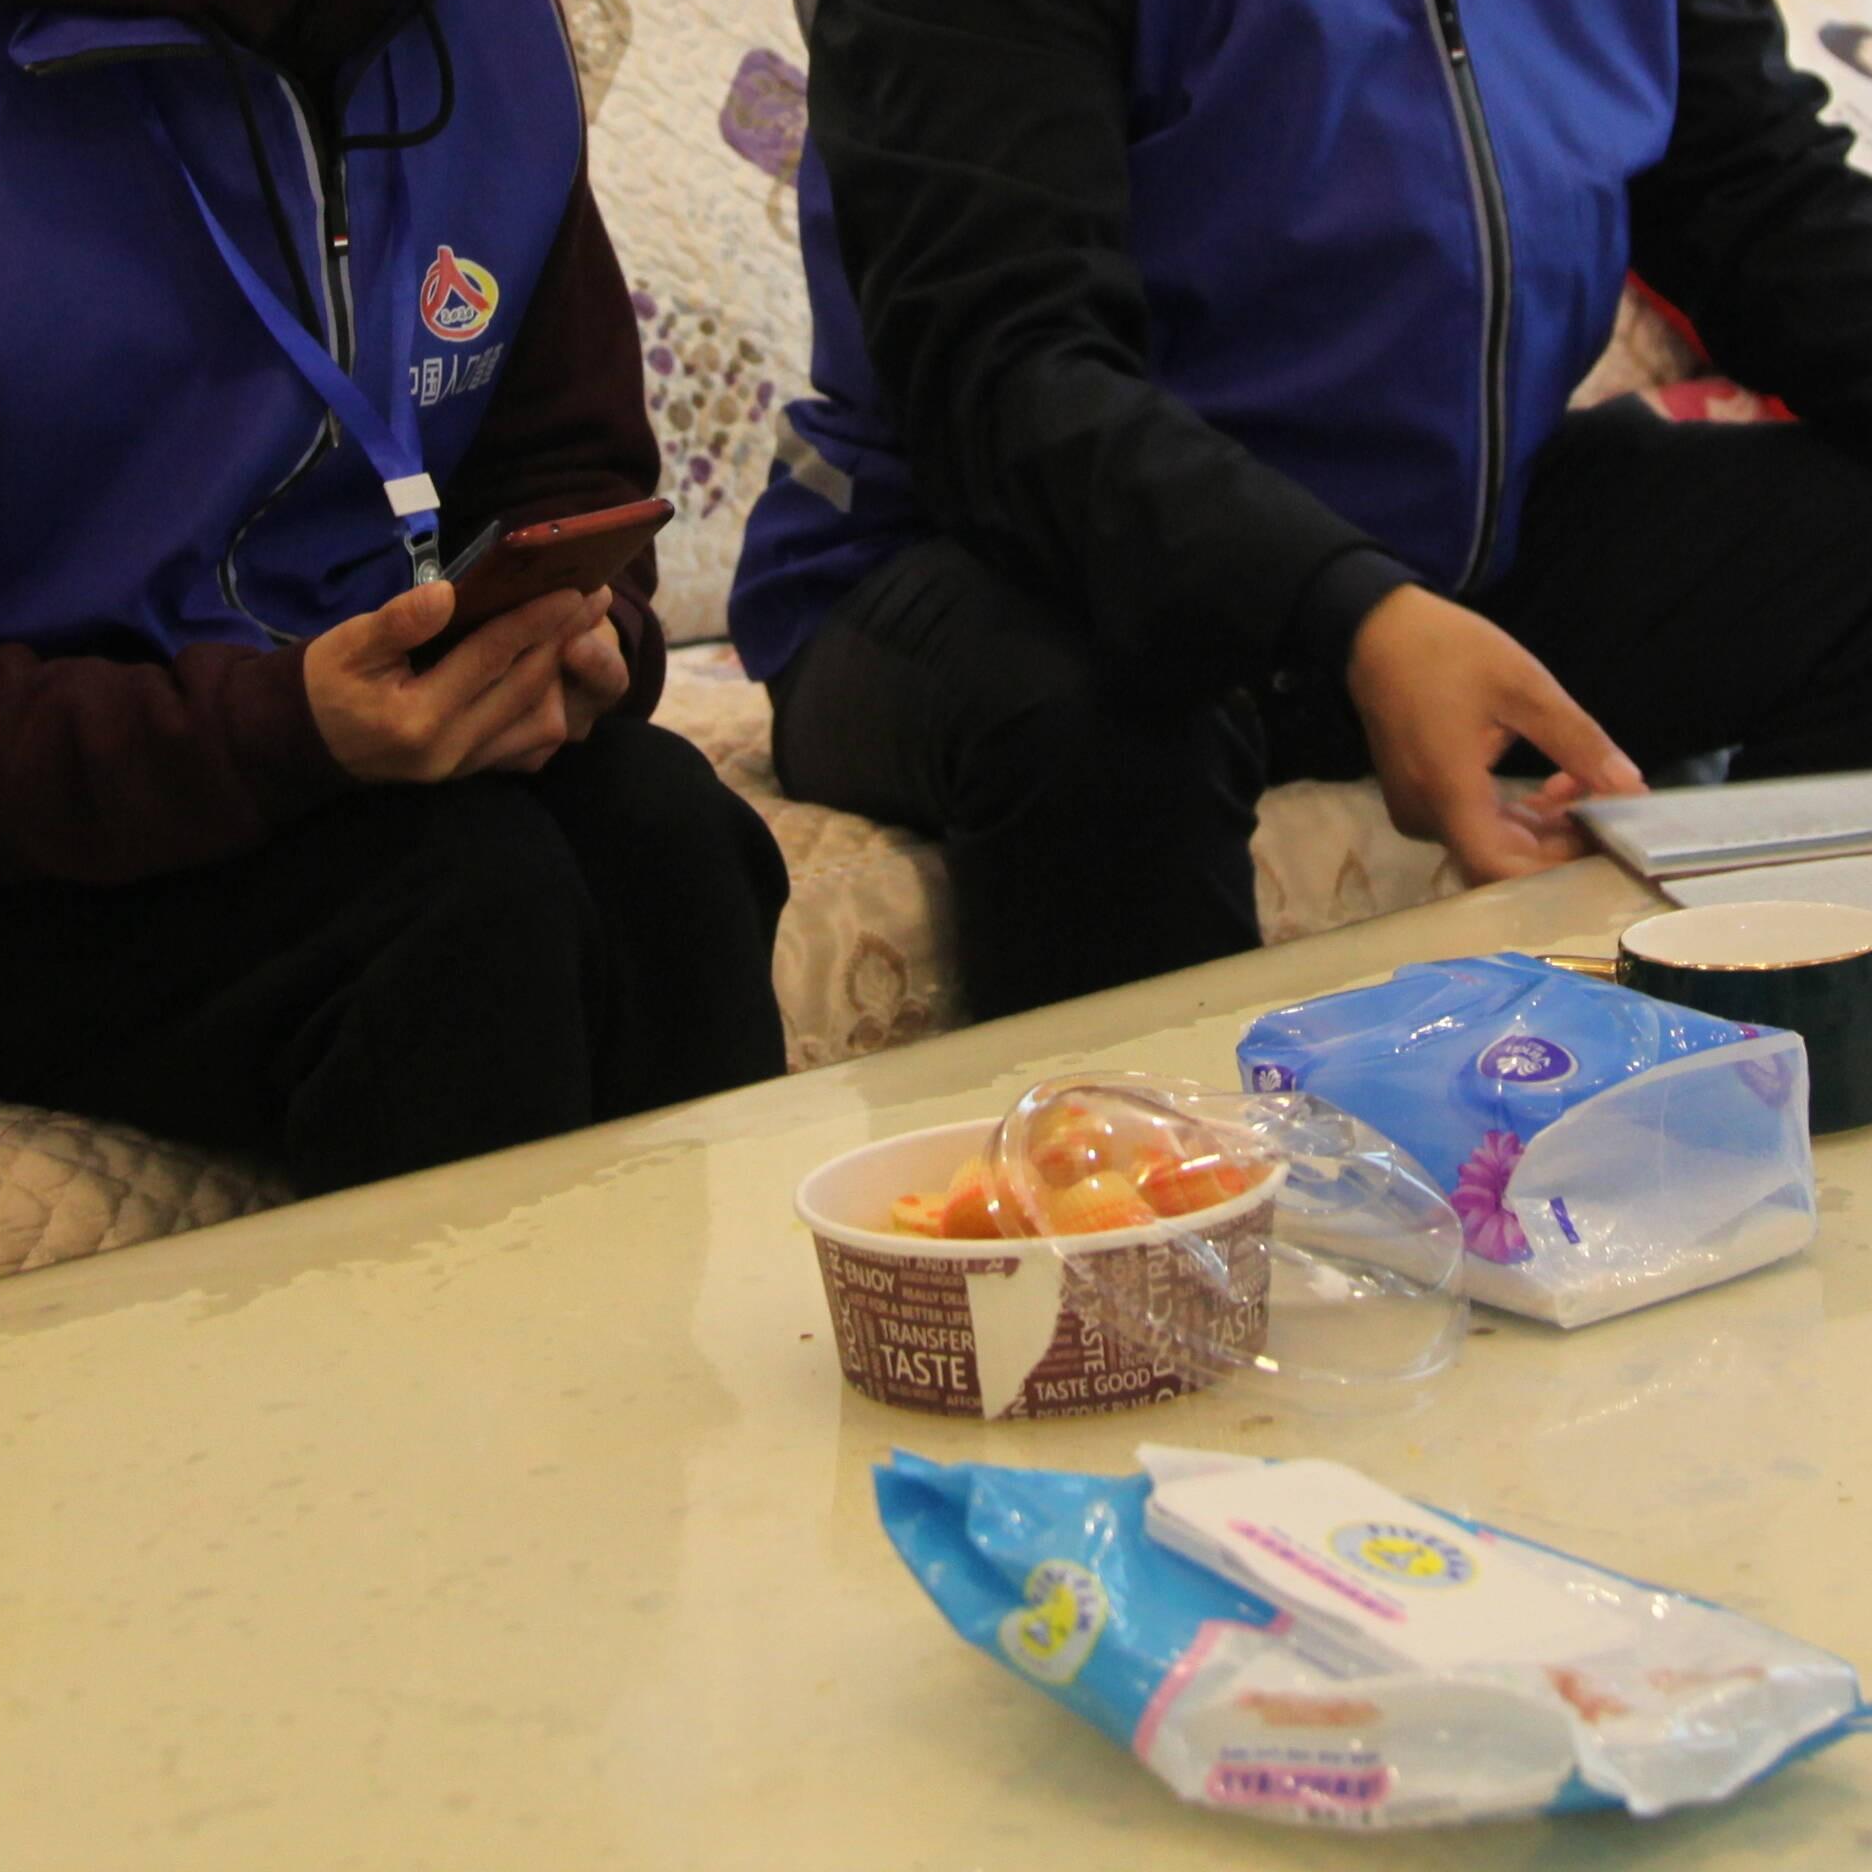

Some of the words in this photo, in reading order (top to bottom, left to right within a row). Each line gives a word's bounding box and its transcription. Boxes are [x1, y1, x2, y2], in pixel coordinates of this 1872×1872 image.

[844, 1260, 896, 1294] ENJOY
[880, 1317, 975, 1353] TRANSFER
[879, 1343, 969, 1391] TASTE
[1033, 1377, 1090, 1402] TASTE
[1093, 1367, 1151, 1396] GOOD
